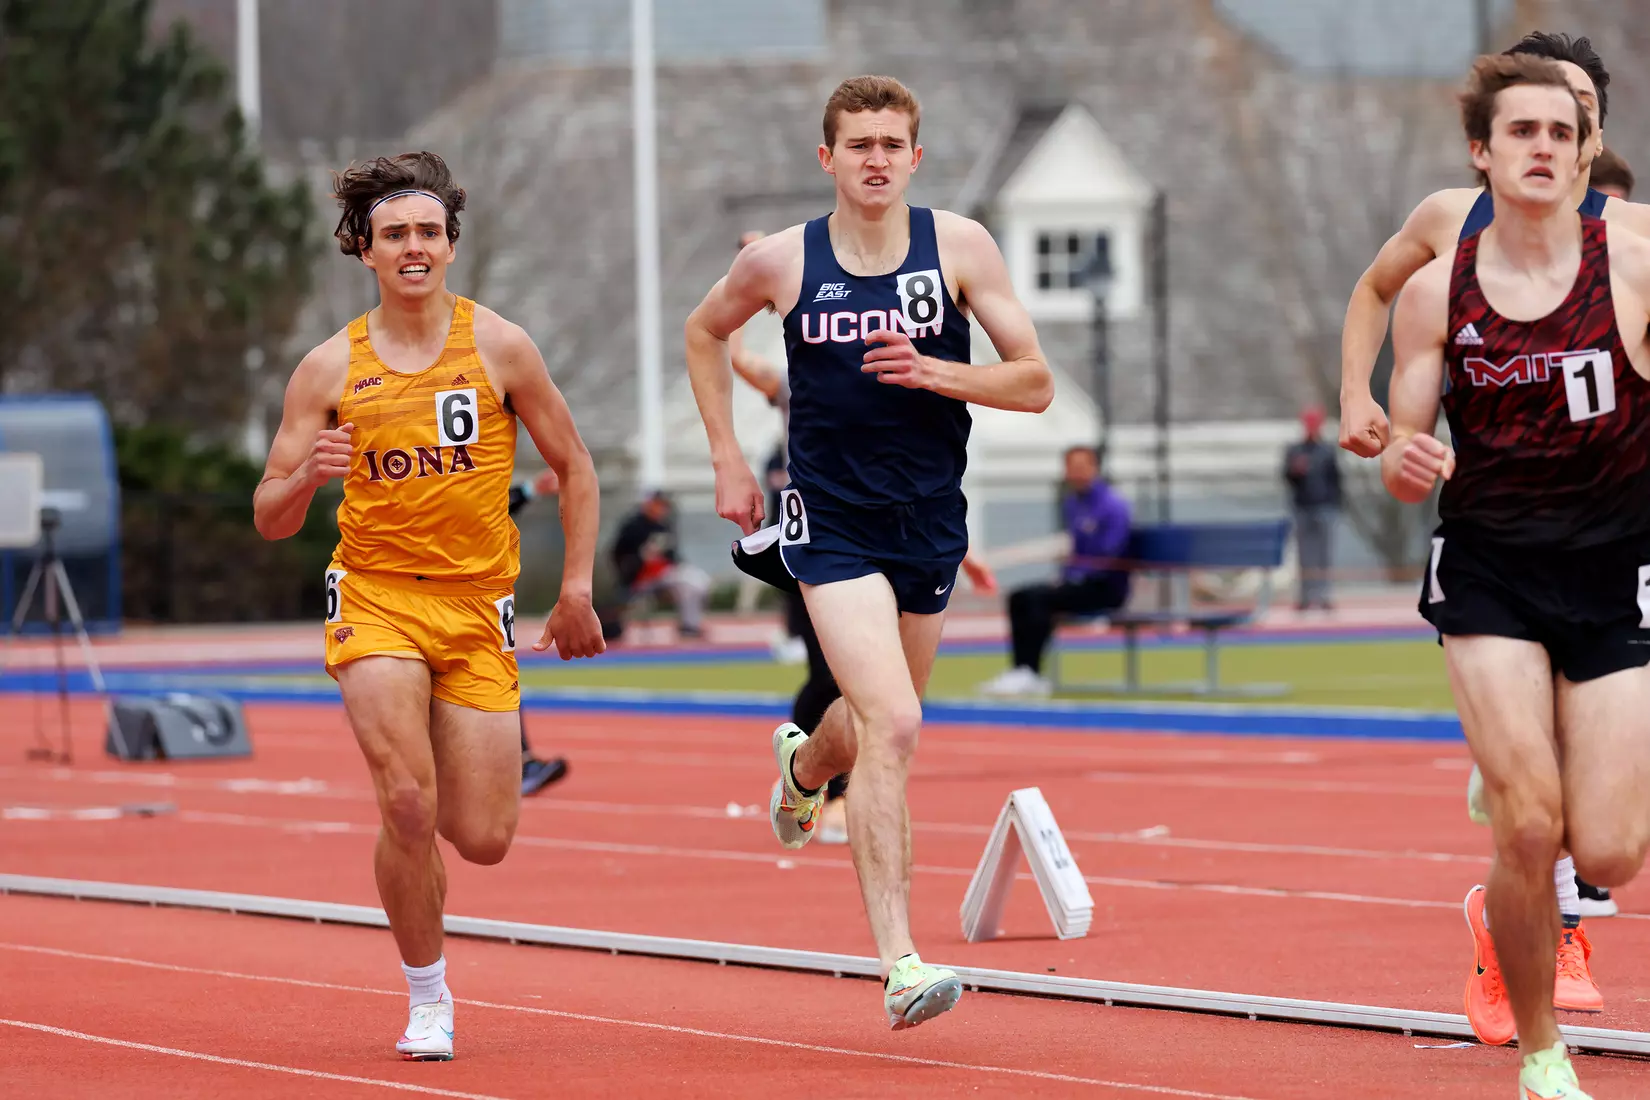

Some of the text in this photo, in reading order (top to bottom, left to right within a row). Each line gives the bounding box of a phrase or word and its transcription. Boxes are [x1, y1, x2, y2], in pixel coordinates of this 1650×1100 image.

[815, 290, 852, 299] EAST
[820, 282, 846, 291] BIG
[905, 274, 938, 324] 8
[353, 376, 383, 394] MAAC
[1573, 360, 1599, 414] 1
[442, 393, 474, 442] 6
[362, 444, 477, 481] IONA
[785, 492, 804, 542] 8
[326, 572, 338, 620] 6
